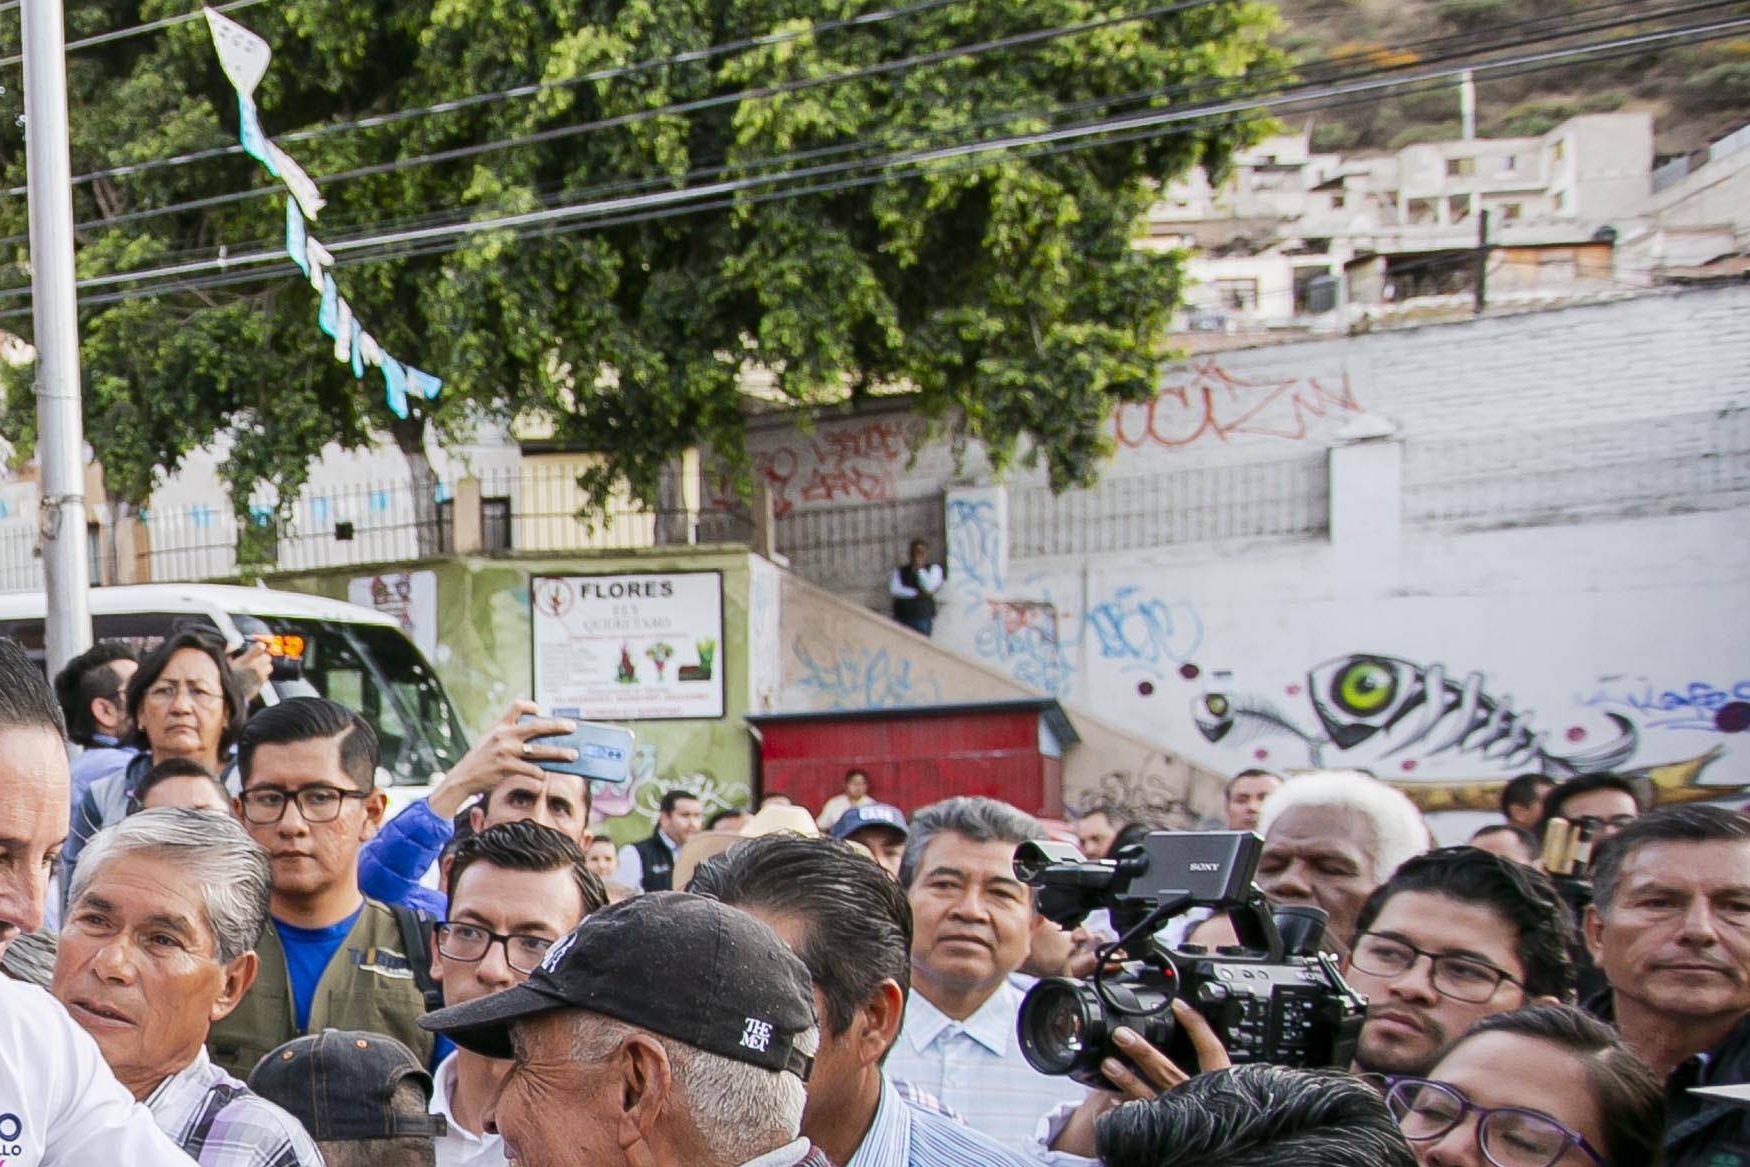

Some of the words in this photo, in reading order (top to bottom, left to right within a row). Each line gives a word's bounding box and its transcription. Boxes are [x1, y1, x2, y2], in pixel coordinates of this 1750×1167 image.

[581, 580, 674, 600] FLORES
[1189, 862, 1220, 872] SONY
[744, 1016, 773, 1038] THE
[738, 1030, 769, 1053] MET
